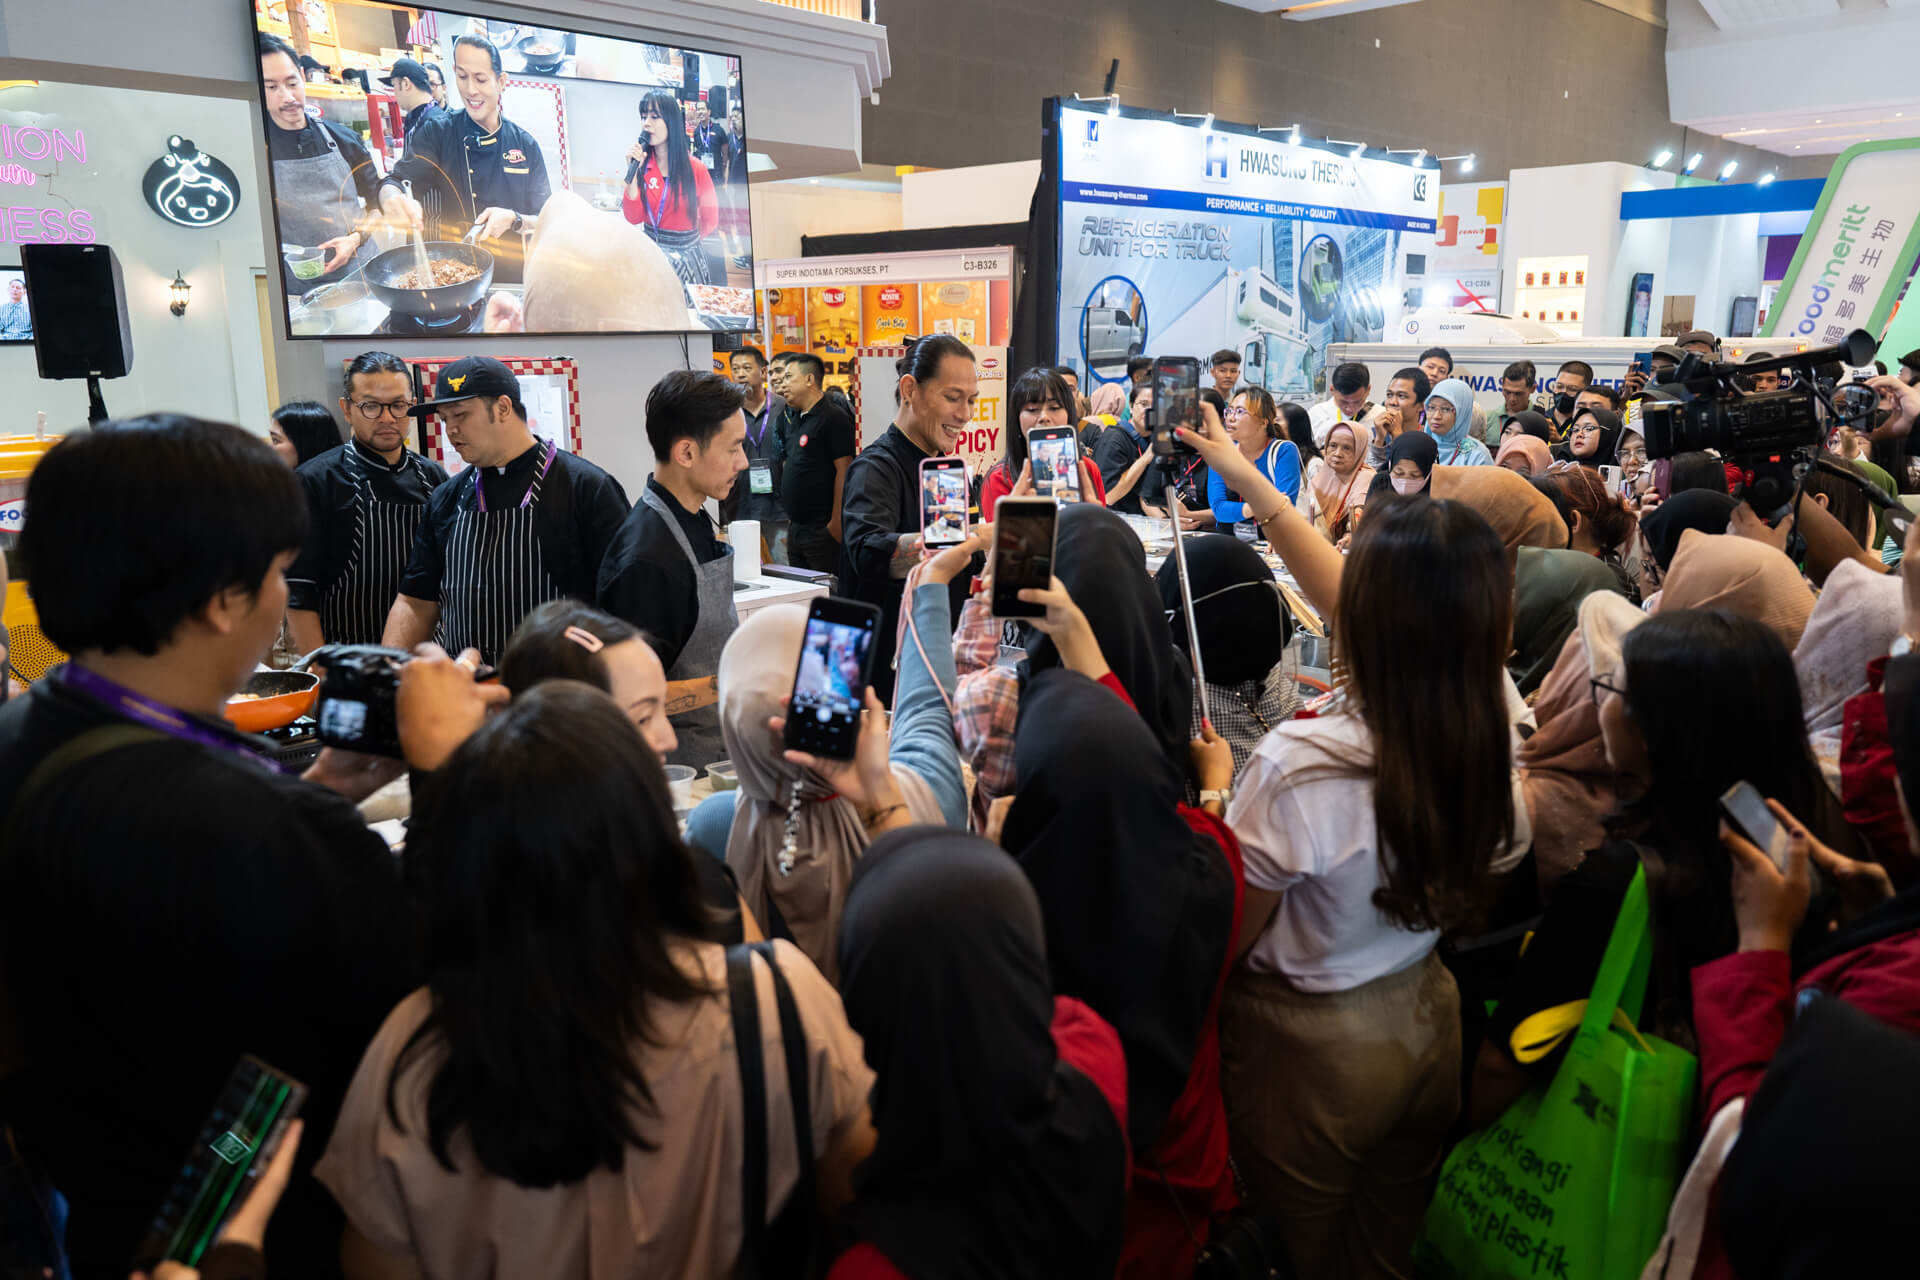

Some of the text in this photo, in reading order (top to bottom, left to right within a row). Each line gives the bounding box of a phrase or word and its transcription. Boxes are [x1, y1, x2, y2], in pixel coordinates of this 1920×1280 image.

[1206, 197, 1337, 220] PERFORMANCE RELIABILITY QUALITY
[0, 207, 96, 244] ESS
[1081, 215, 1232, 243] REFRIGERATION
[1079, 237, 1233, 262] UNIT FOR TRUCK
[776, 269, 798, 279] SUPER
[799, 267, 833, 278] INDOTAMA
[880, 265, 889, 274] PT
[963, 260, 998, 271] C3-B326
[1790, 203, 1871, 336] oodmeritt
[972, 397, 1000, 422] EET
[944, 427, 1000, 456] PICY
